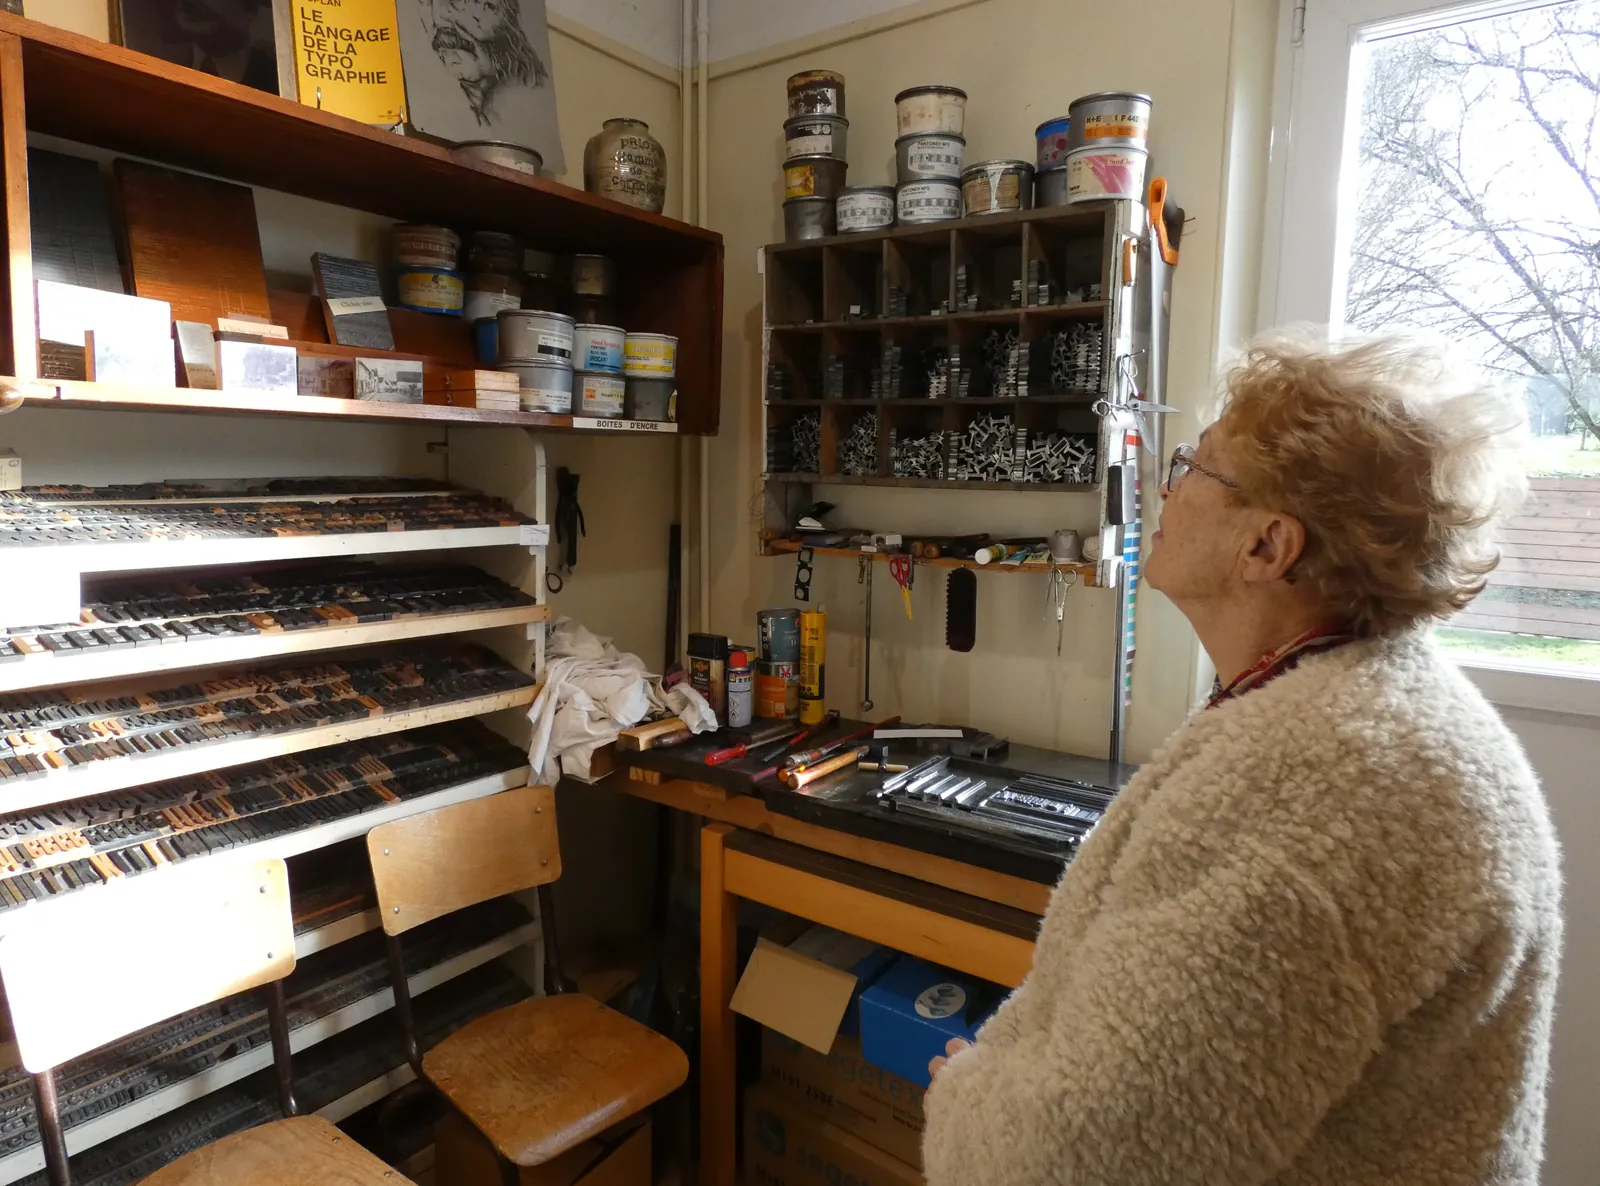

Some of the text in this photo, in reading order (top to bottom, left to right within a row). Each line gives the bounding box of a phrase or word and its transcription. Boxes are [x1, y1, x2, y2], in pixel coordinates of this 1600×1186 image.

[301, 7, 323, 23] LE
[302, 21, 390, 42] LANGAGE
[303, 35, 357, 56] DE LA
[304, 48, 353, 69] TYPO
[305, 64, 387, 84] GRAPHIE
[597, 420, 659, 430] BOITES D'ENCRE
